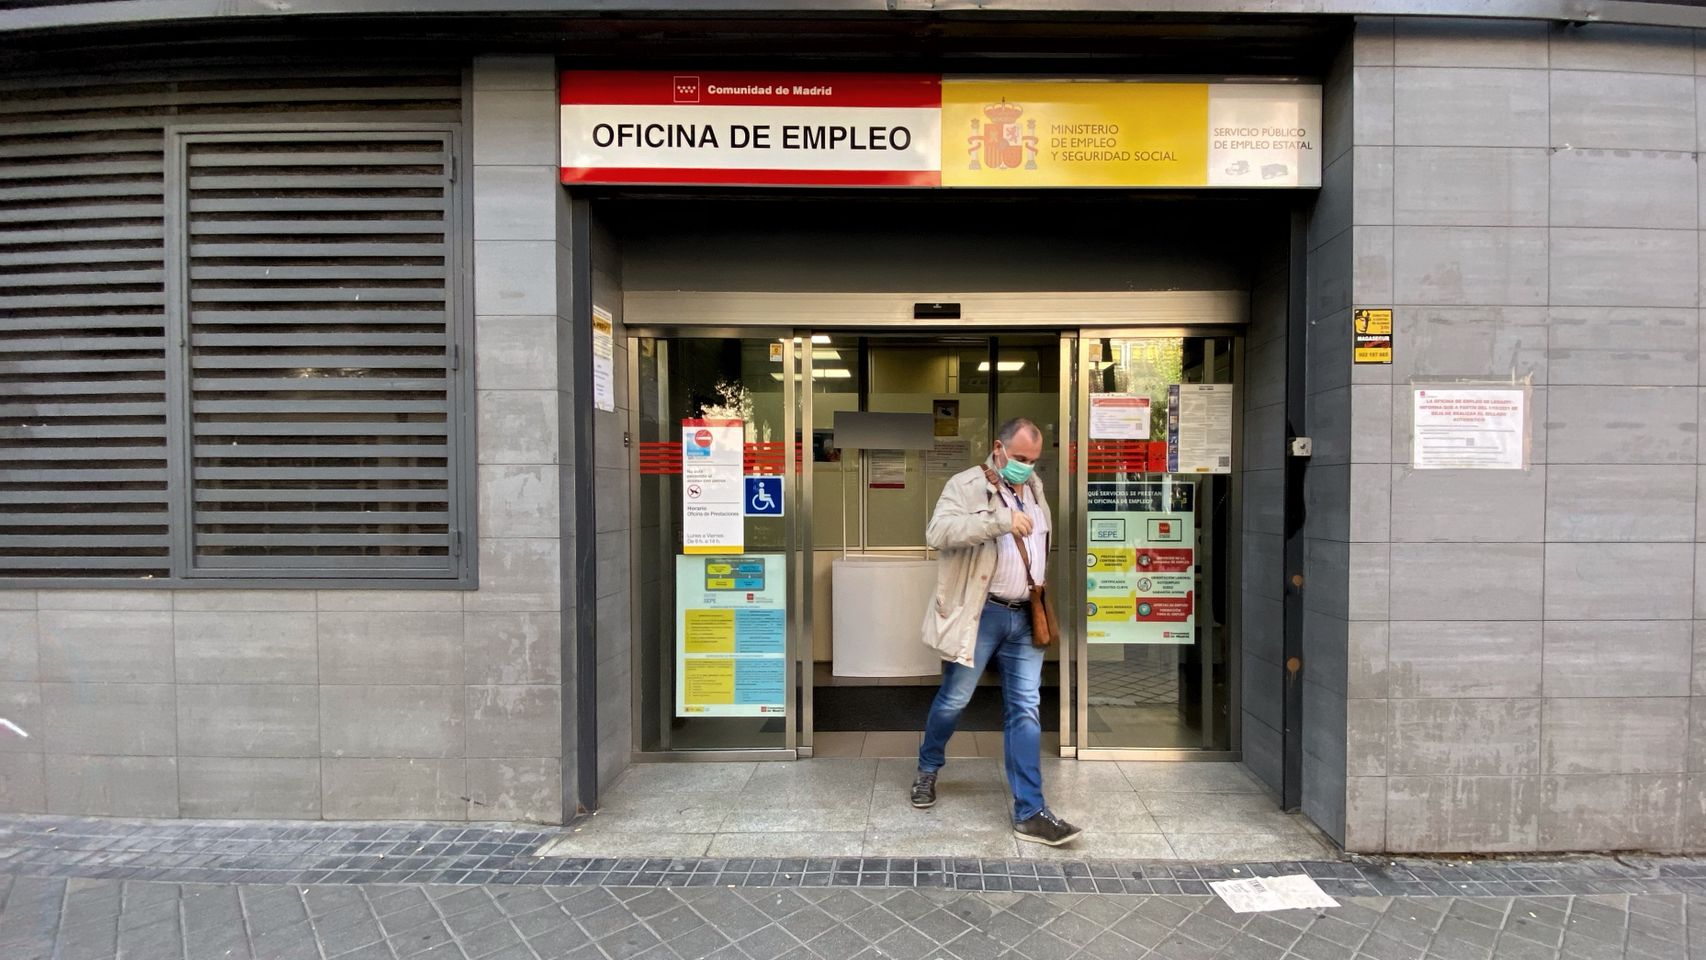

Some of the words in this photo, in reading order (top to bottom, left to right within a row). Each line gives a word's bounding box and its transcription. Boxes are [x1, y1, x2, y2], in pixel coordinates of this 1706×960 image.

[707, 84, 772, 96] Comunidad
[775, 85, 790, 96] de
[793, 85, 832, 97] Madrid
[1050, 123, 1119, 136] MINISTERIO
[1213, 126, 1260, 138] SERVICIO
[1261, 125, 1306, 138] PÚBLICO
[592, 123, 719, 149] OFICINA
[730, 124, 771, 149] DE
[782, 125, 912, 151] EMPLEO
[1050, 137, 1069, 149] DE
[1070, 137, 1117, 149] EMPLEO
[1213, 139, 1229, 150] DE
[1230, 139, 1271, 150] EMPLEO
[1272, 139, 1313, 151] ESTATAL
[1050, 150, 1060, 162] Y
[1061, 150, 1132, 162] SEGURIDAD
[1134, 150, 1179, 162] SOCIAL
[1097, 530, 1118, 538] SEPE
